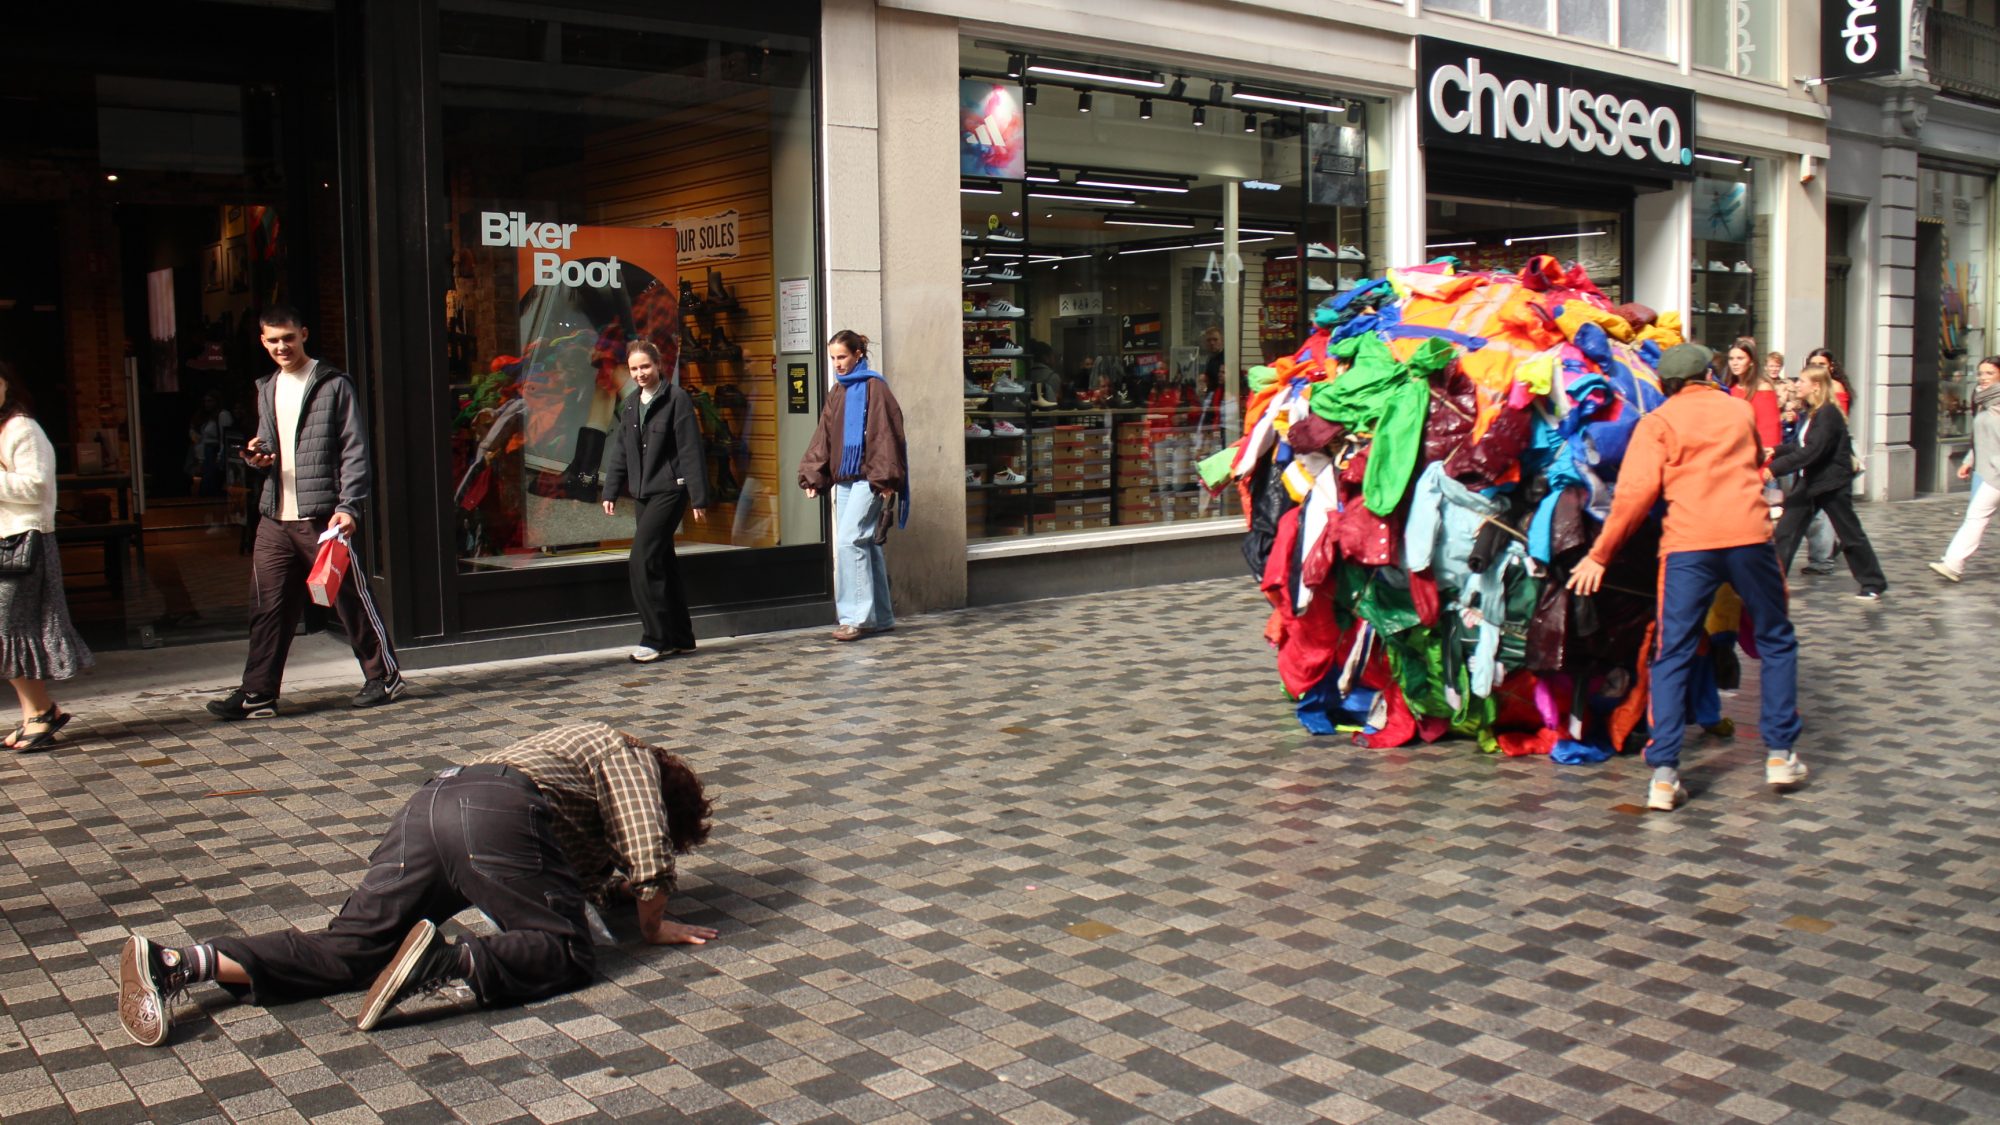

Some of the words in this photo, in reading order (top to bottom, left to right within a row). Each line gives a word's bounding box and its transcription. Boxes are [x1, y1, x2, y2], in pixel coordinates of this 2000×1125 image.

[481, 211, 578, 250] Biker
[699, 222, 735, 250] SOLES
[533, 252, 622, 289] Boot
